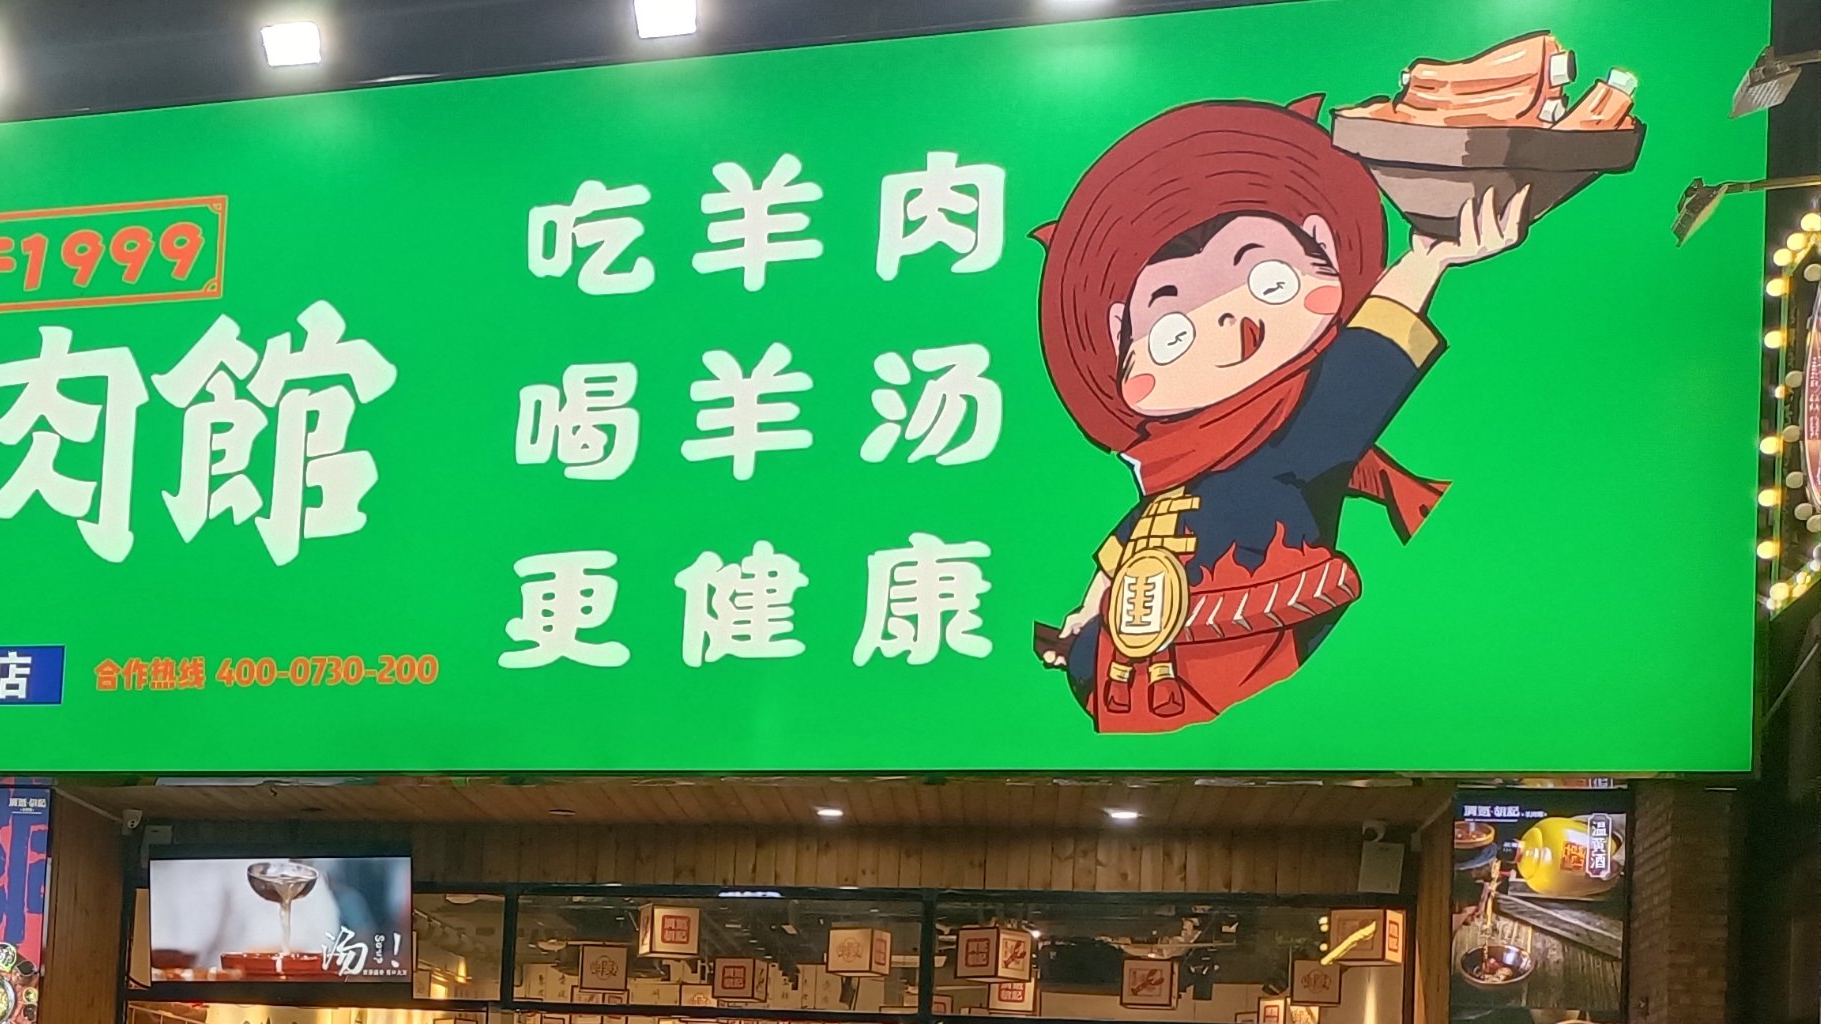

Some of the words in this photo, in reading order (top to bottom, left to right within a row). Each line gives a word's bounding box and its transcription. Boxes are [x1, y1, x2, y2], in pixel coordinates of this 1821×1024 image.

[95, 657, 206, 691] 合作热线
[216, 654, 439, 687] 400-0730-200
[373, 933, 386, 965] Soup
